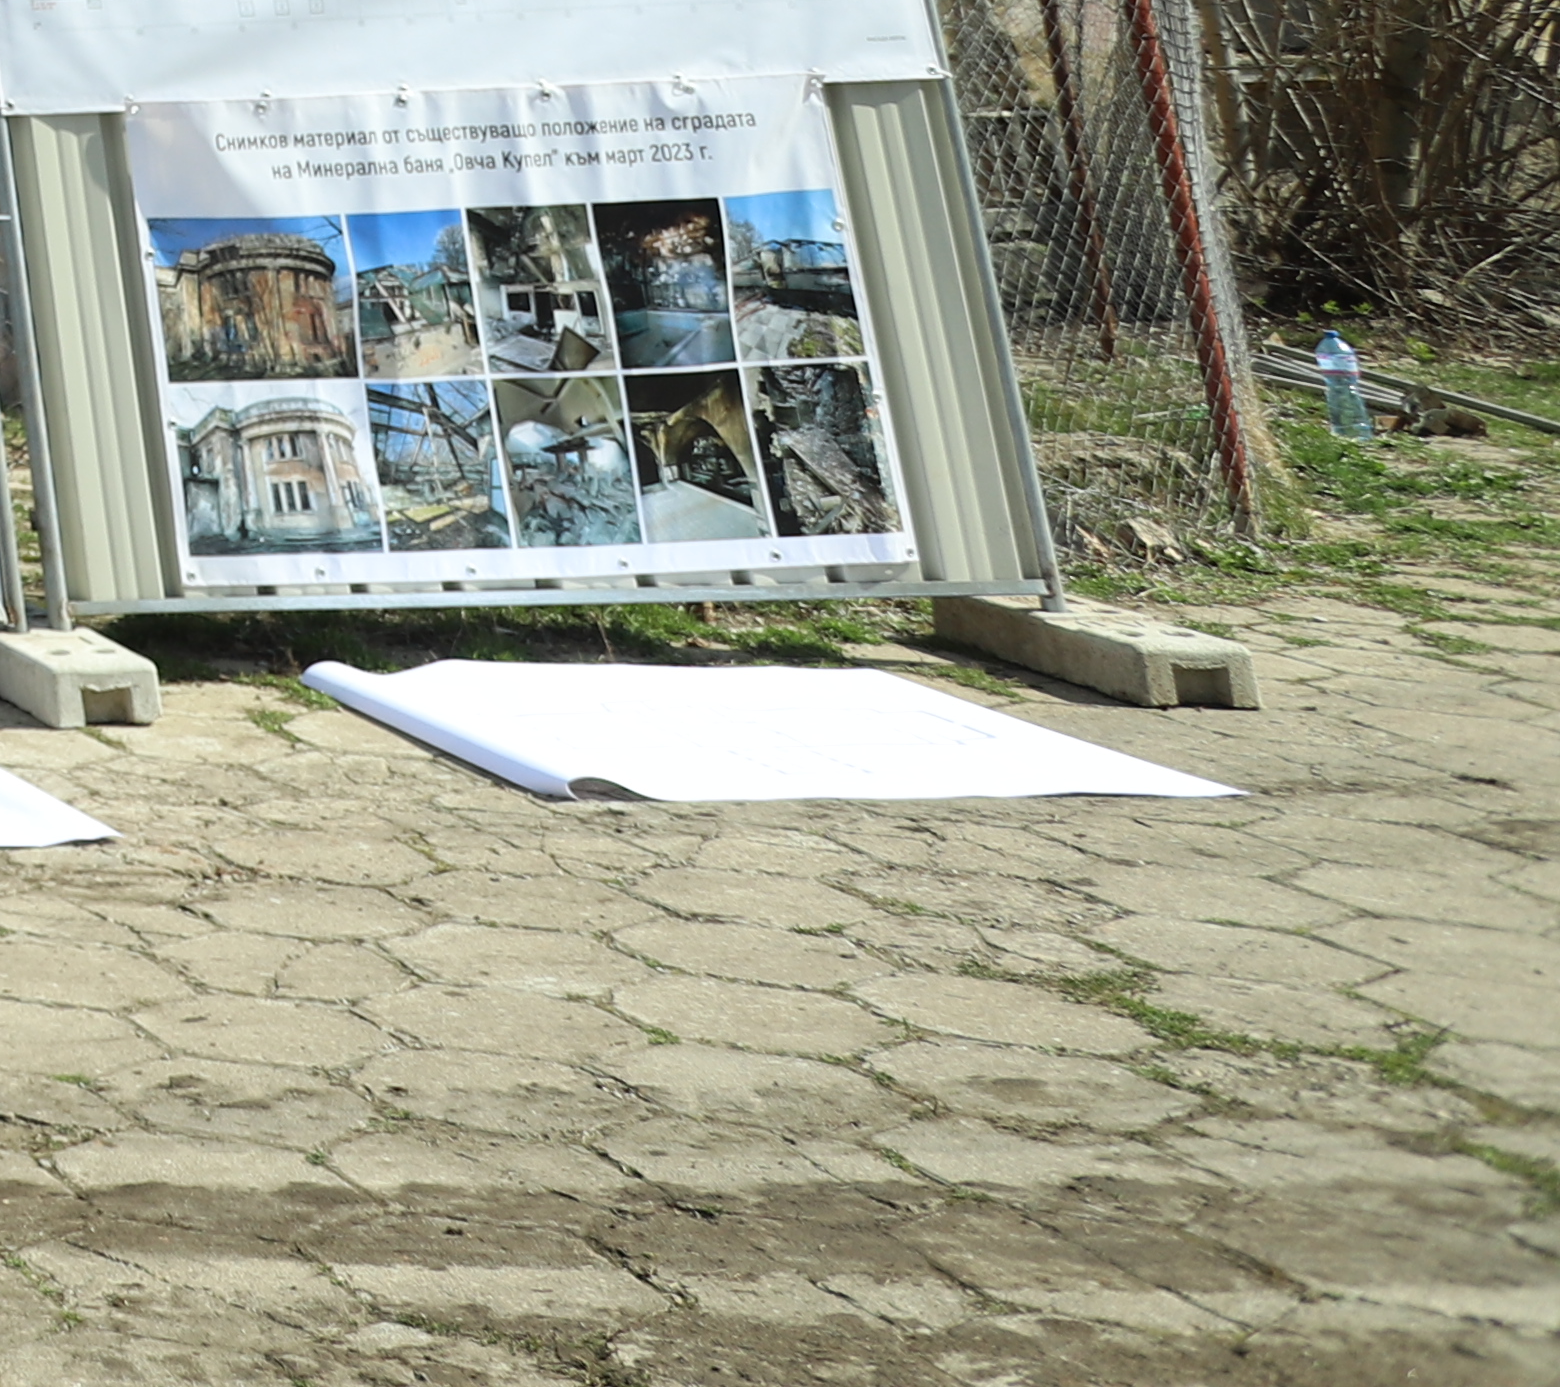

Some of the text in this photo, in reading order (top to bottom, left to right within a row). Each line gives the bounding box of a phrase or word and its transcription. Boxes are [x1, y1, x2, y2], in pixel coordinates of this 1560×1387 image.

[215, 112, 756, 152] Снимков материал от съществуващо положение на сградата
[272, 165, 292, 180] на
[298, 156, 398, 182] Минерална
[404, 154, 443, 174] баня
[449, 151, 496, 174] „Овча
[565, 150, 600, 167] към
[604, 148, 645, 169] март
[650, 142, 694, 163] 2023
[700, 145, 712, 160] г.
